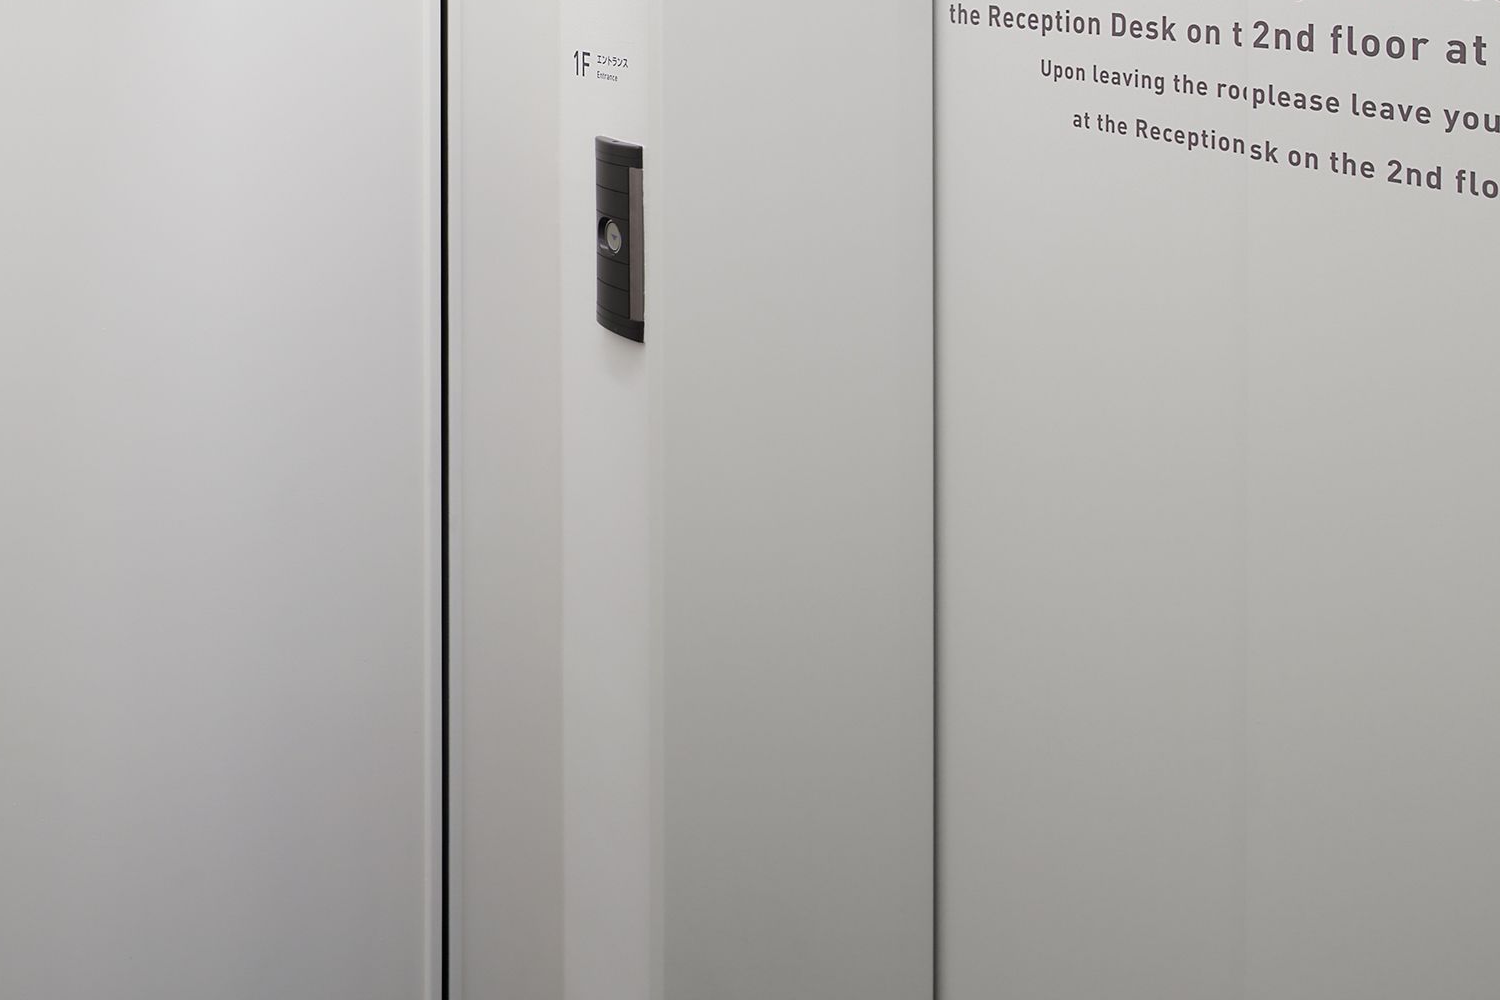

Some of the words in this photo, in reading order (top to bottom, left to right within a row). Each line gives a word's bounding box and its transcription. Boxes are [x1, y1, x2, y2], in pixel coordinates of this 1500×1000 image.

[949, 2, 981, 26] the
[988, 4, 1101, 37] Reception
[1111, 12, 1177, 42] Desk
[1187, 23, 1221, 46] on
[1252, 20, 1314, 53] 2nd
[1330, 24, 1430, 61] floor
[1445, 35, 1487, 66] at
[573, 50, 591, 77] 1F
[596, 54, 630, 69] エントランス
[596, 69, 619, 83] Entrance
[1040, 58, 1086, 83] Upon
[1093, 64, 1165, 96] leaving
[1173, 73, 1208, 96] the
[1252, 84, 1340, 114] please
[1351, 92, 1432, 125] leave
[1443, 108, 1500, 134] you
[1072, 112, 1091, 130] at
[1096, 113, 1128, 136] the
[1135, 118, 1245, 155] Reception
[1288, 149, 1319, 171] on
[1329, 151, 1375, 179] the
[1387, 159, 1442, 191] 2nd
[1455, 169, 1499, 199] flo
